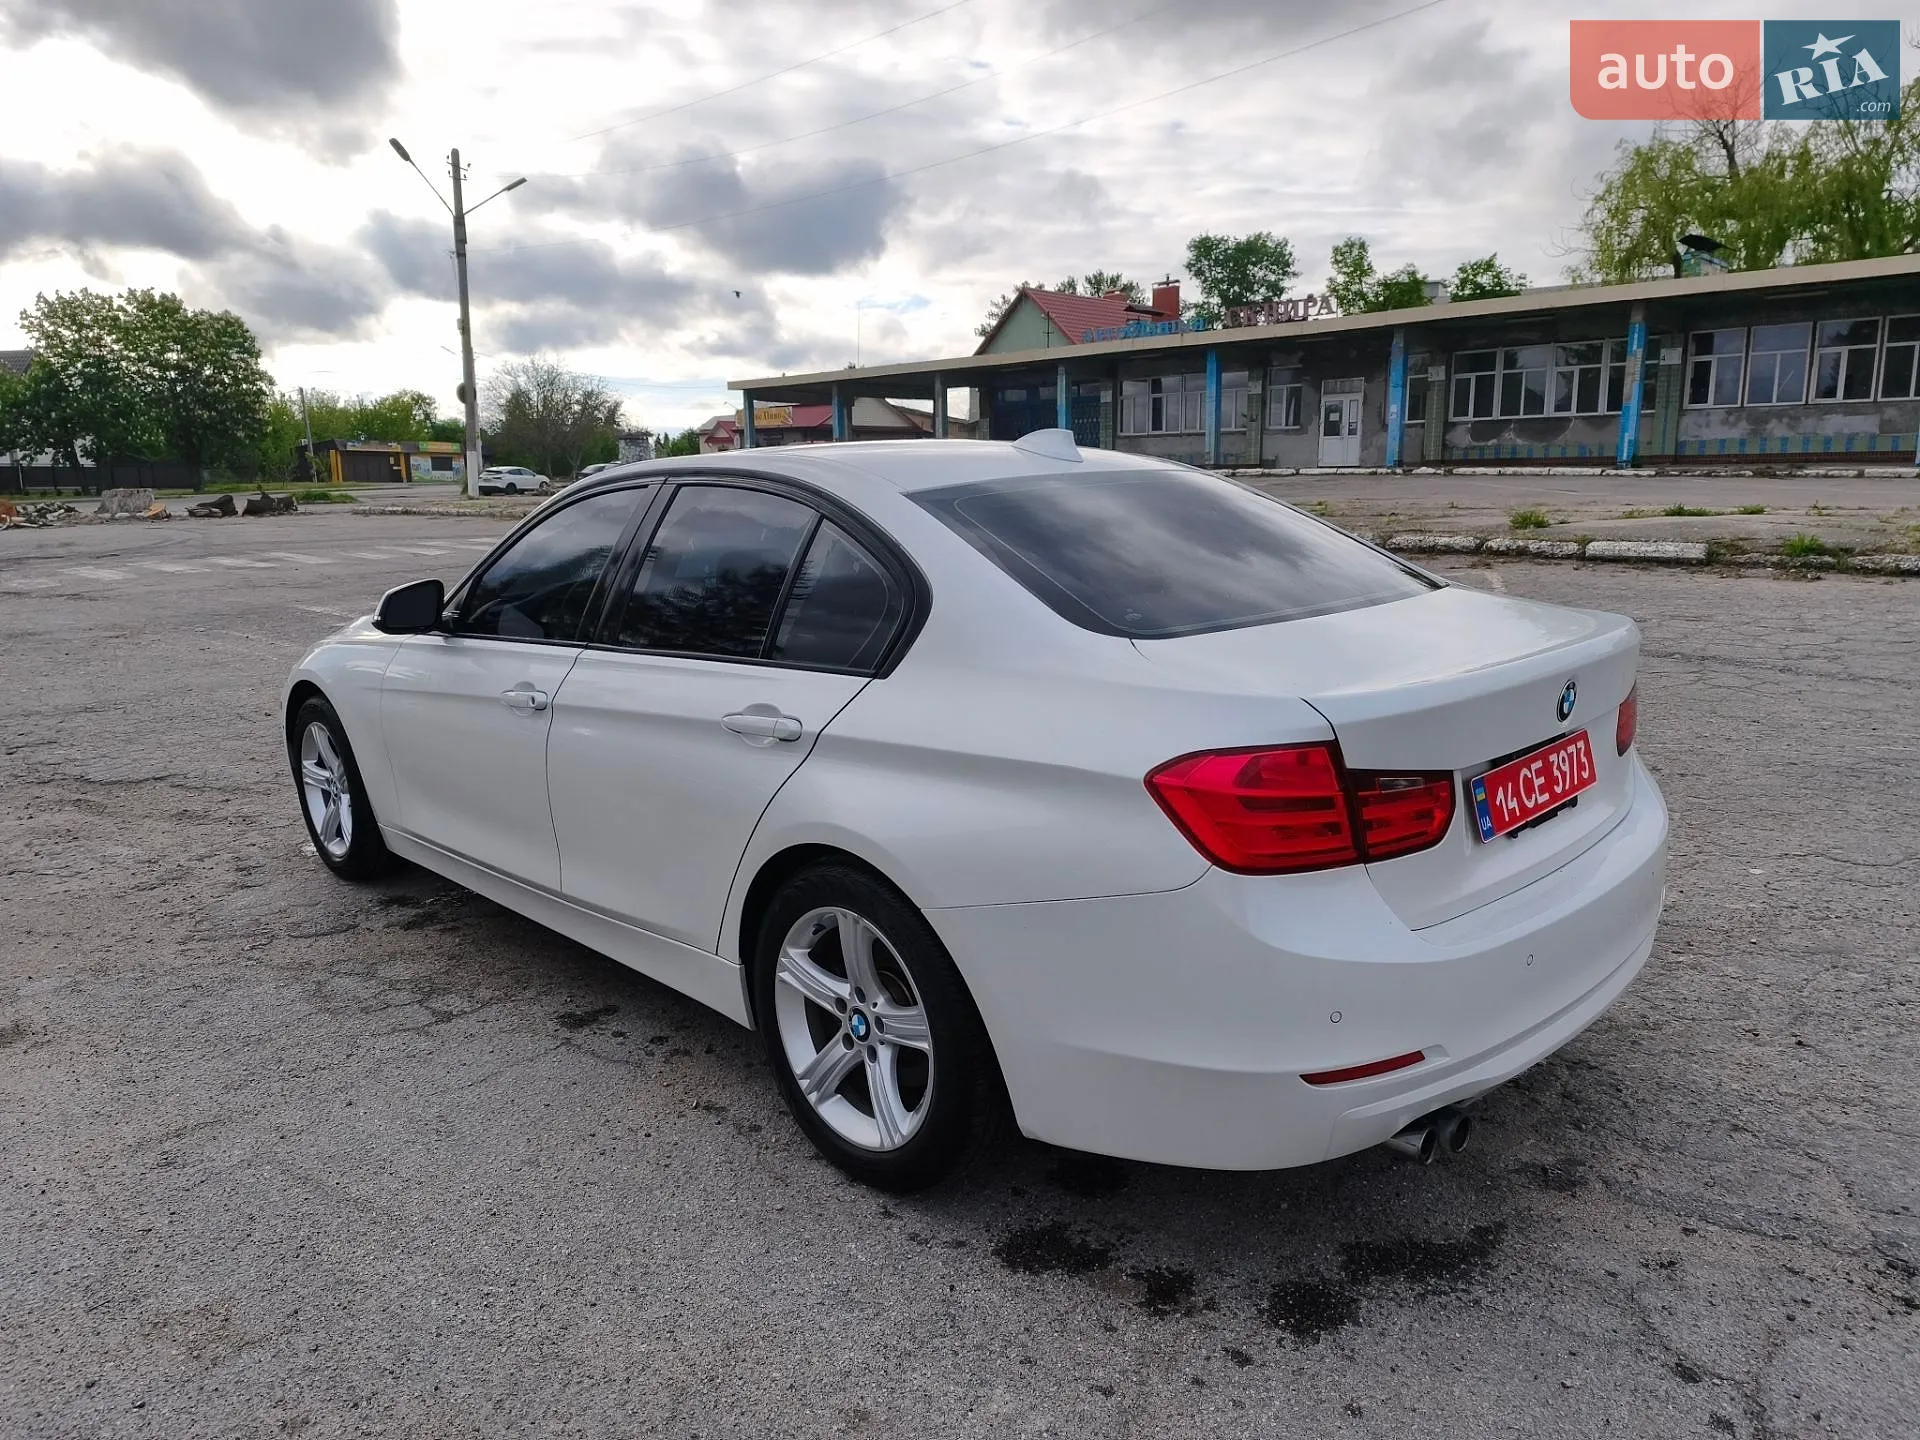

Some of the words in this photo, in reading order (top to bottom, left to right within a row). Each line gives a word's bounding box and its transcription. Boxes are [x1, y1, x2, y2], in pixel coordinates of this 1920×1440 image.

[1495, 782, 1520, 822] 14
[1519, 760, 1550, 809] CE
[1549, 739, 1590, 794] 3973
[1480, 815, 1493, 830] UA
